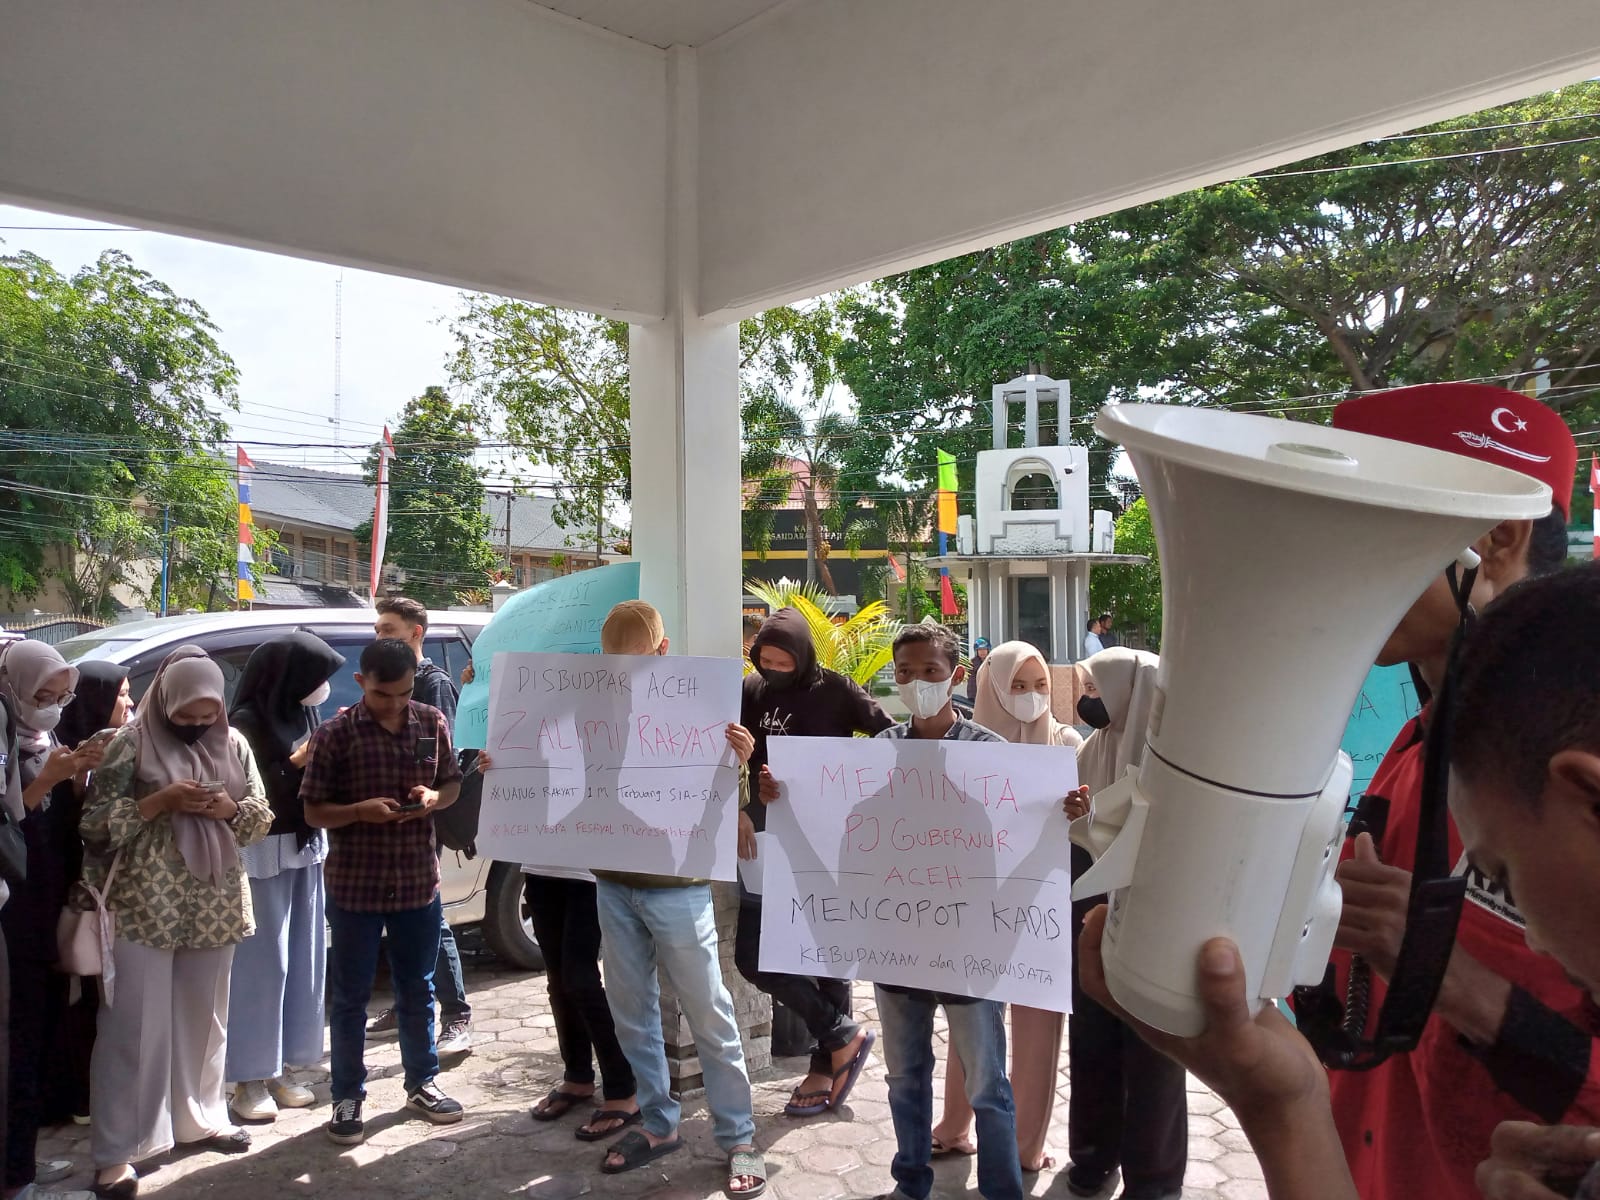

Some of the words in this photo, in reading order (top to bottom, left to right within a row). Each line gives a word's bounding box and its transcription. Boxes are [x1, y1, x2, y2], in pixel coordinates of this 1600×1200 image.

[518, 666, 632, 693] DISBUDPAR
[648, 672, 699, 699] ACEH
[498, 711, 621, 753] ZALIMI
[637, 715, 727, 759] RAKYAT
[543, 786, 579, 798] RAKYAT
[616, 785, 661, 801] Terbuang
[669, 787, 722, 802] SIA-SIA
[820, 763, 1019, 814] MEMINTA
[503, 824, 530, 836] ACEH
[535, 823, 567, 836] VESPA
[845, 814, 880, 852] PJ
[891, 817, 1014, 853] GUBERNUR
[884, 866, 963, 889] ACEH
[791, 894, 969, 928] MENCOPOT
[991, 900, 1061, 940] KADIS
[800, 944, 920, 967] KEBUDAYAAN
[929, 953, 956, 972] dan
[963, 953, 1053, 985] PARIWISATA
